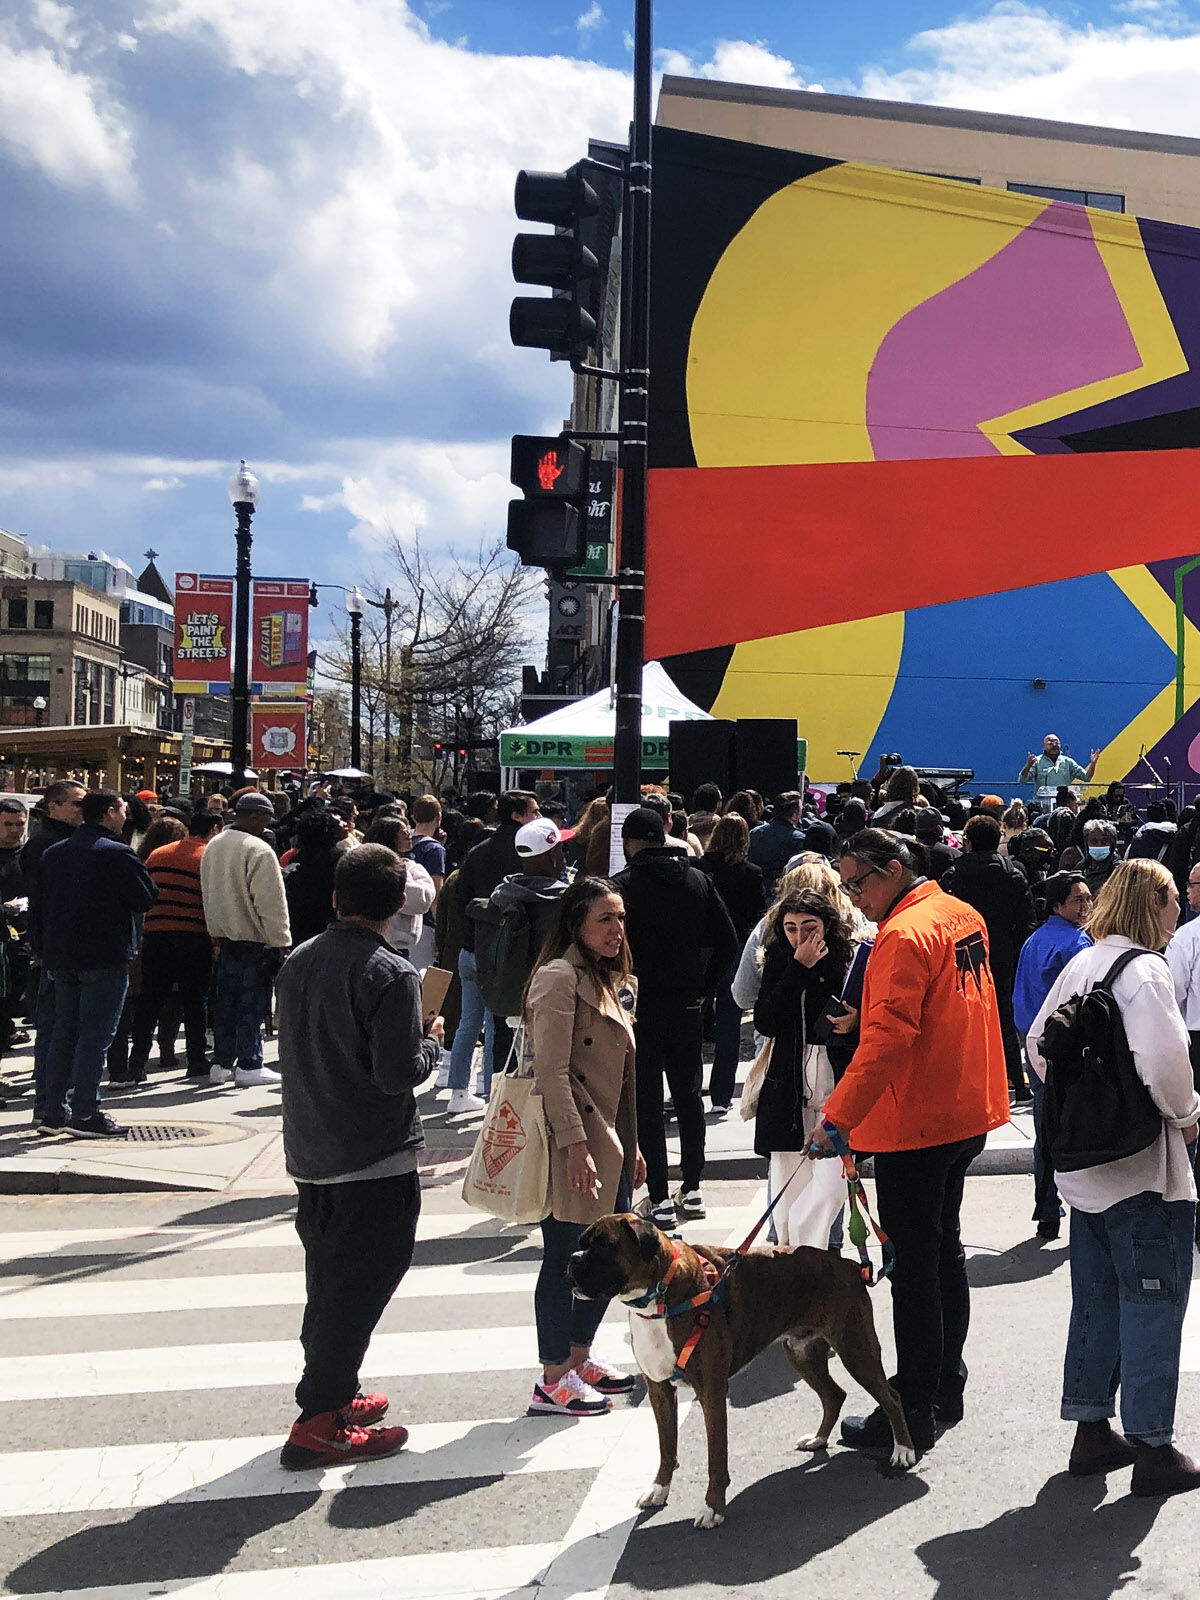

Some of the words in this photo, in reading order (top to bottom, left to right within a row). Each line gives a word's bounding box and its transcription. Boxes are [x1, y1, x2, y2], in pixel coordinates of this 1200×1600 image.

[187, 614, 219, 624] LET'S
[187, 625, 217, 636] PAINT
[556, 623, 584, 635] ACE
[192, 636, 212, 647] THE
[261, 620, 270, 661] LOGAN
[178, 647, 227, 658] STREETS
[526, 741, 572, 756] DPR
[642, 741, 669, 756] DP
